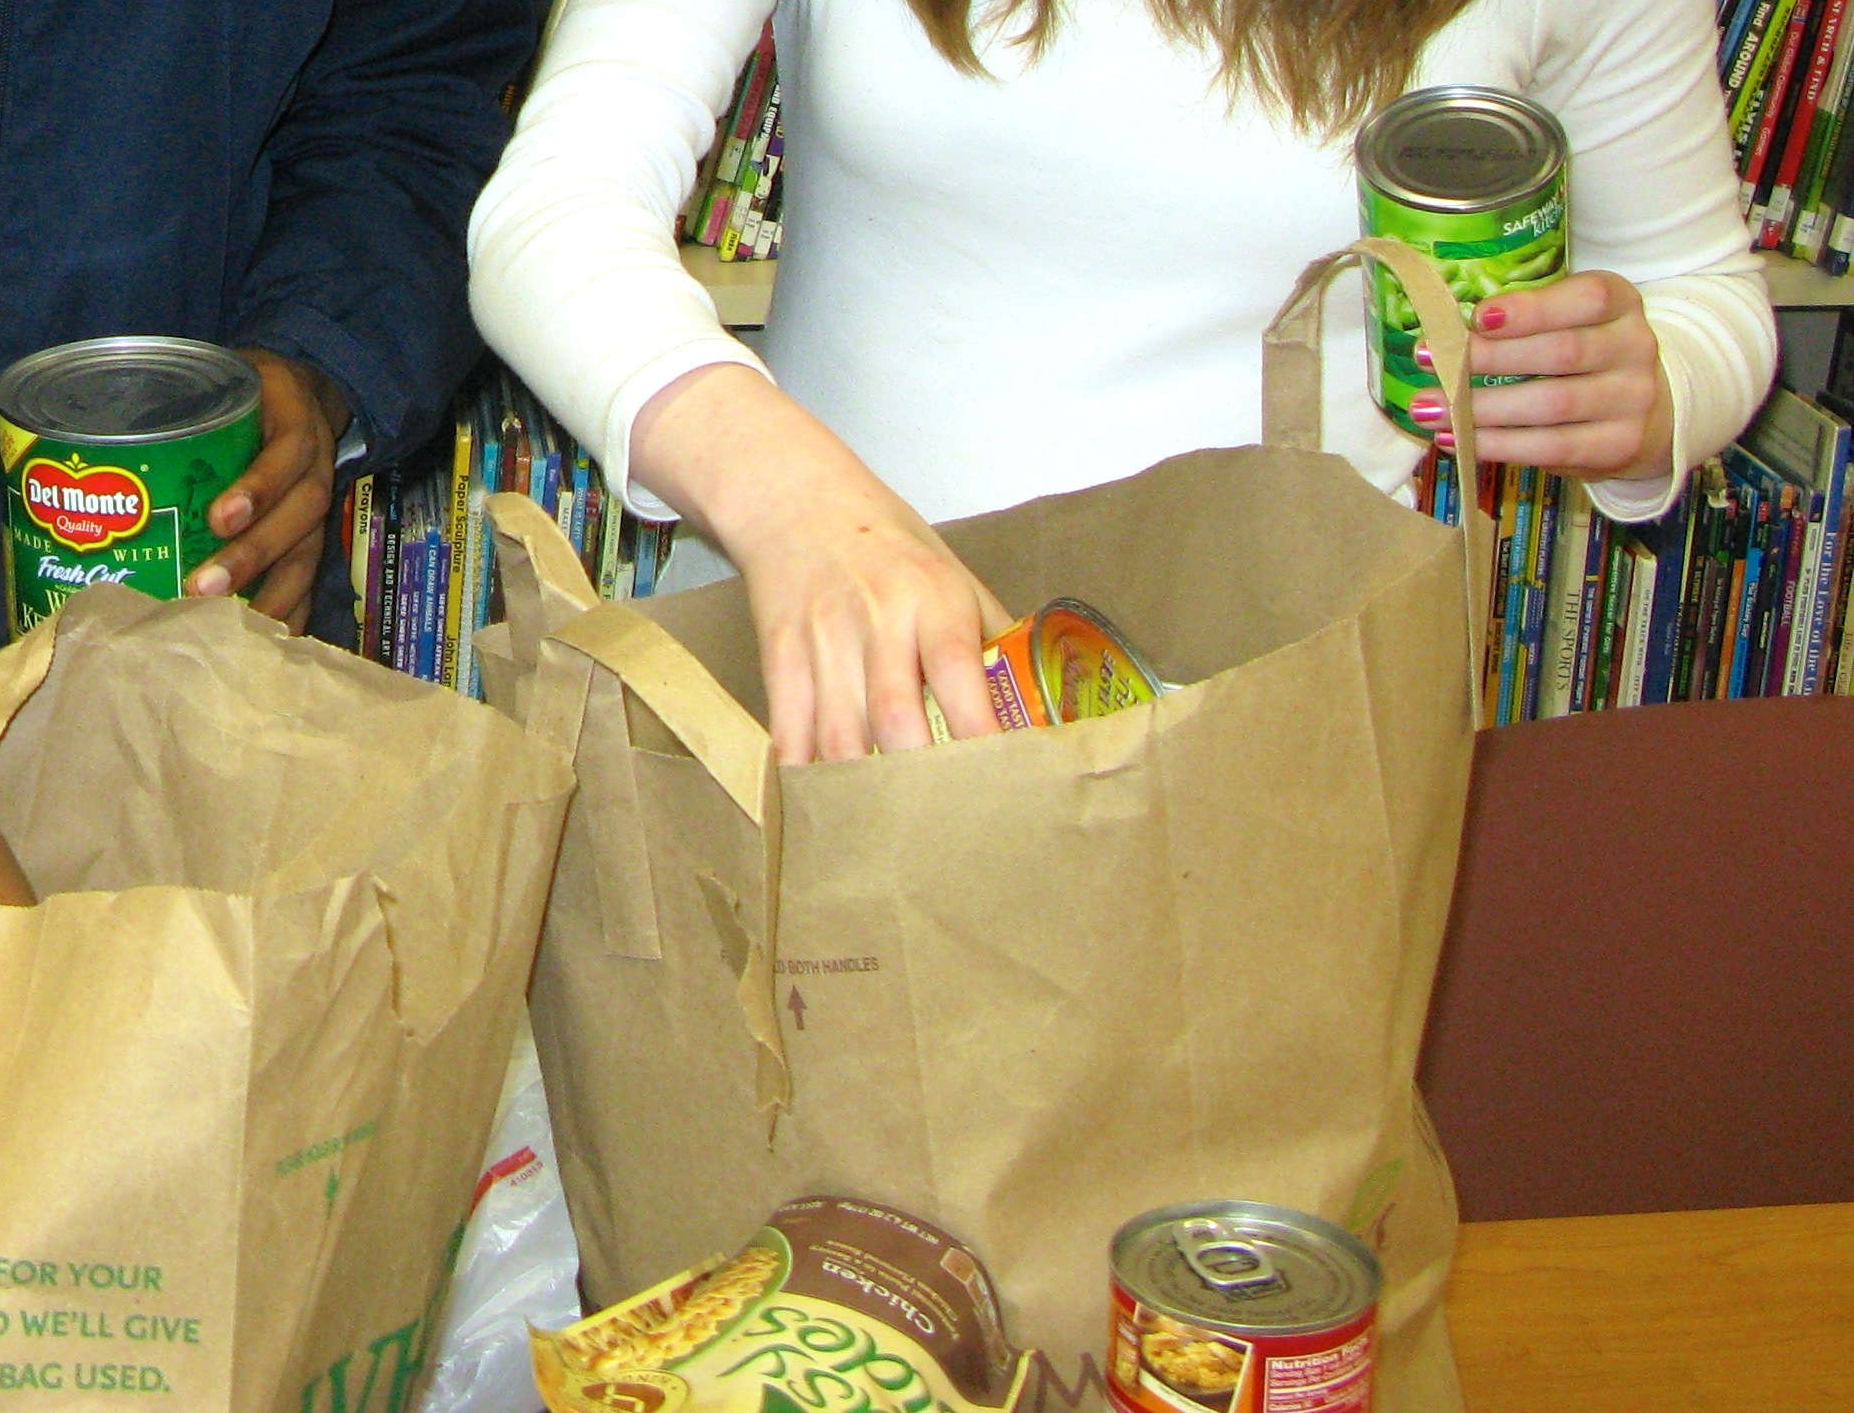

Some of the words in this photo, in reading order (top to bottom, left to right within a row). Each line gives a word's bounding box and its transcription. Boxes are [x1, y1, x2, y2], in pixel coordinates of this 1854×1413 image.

[1751, 0, 1769, 28] Find
[1726, 30, 1758, 90] AROUND
[29, 479, 59, 509] Del
[64, 487, 139, 515] Monte
[356, 482, 370, 534] Crayons
[455, 474, 468, 512] Paper
[56, 515, 103, 537] Quality
[14, 528, 52, 553] MADE
[113, 546, 169, 563] WITH
[386, 533, 395, 564] DESIGN
[428, 549, 436, 566] CAN
[450, 514, 464, 573] Sculpture
[38, 555, 84, 583] Fresh
[384, 567, 394, 585] AND
[427, 569, 435, 593] DRAW
[382, 588, 392, 635] TECHNICAL
[424, 595, 433, 632] ANIMALS
[1561, 589, 1580, 623] THE
[1780, 580, 1794, 626] FOOTBALL
[381, 639, 390, 656] ART
[1552, 628, 1576, 692] SPORTS
[788, 959, 820, 975] BOTH
[822, 956, 879, 973] HANDLES
[67, 1261, 163, 1290] YOUR
[822, 1260, 935, 1334] Chicken
[21, 1309, 114, 1340] WE'LL
[123, 1315, 201, 1344] GIVE
[1271, 1351, 1340, 1370] Nutrition
[75, 1363, 170, 1393] USED.
